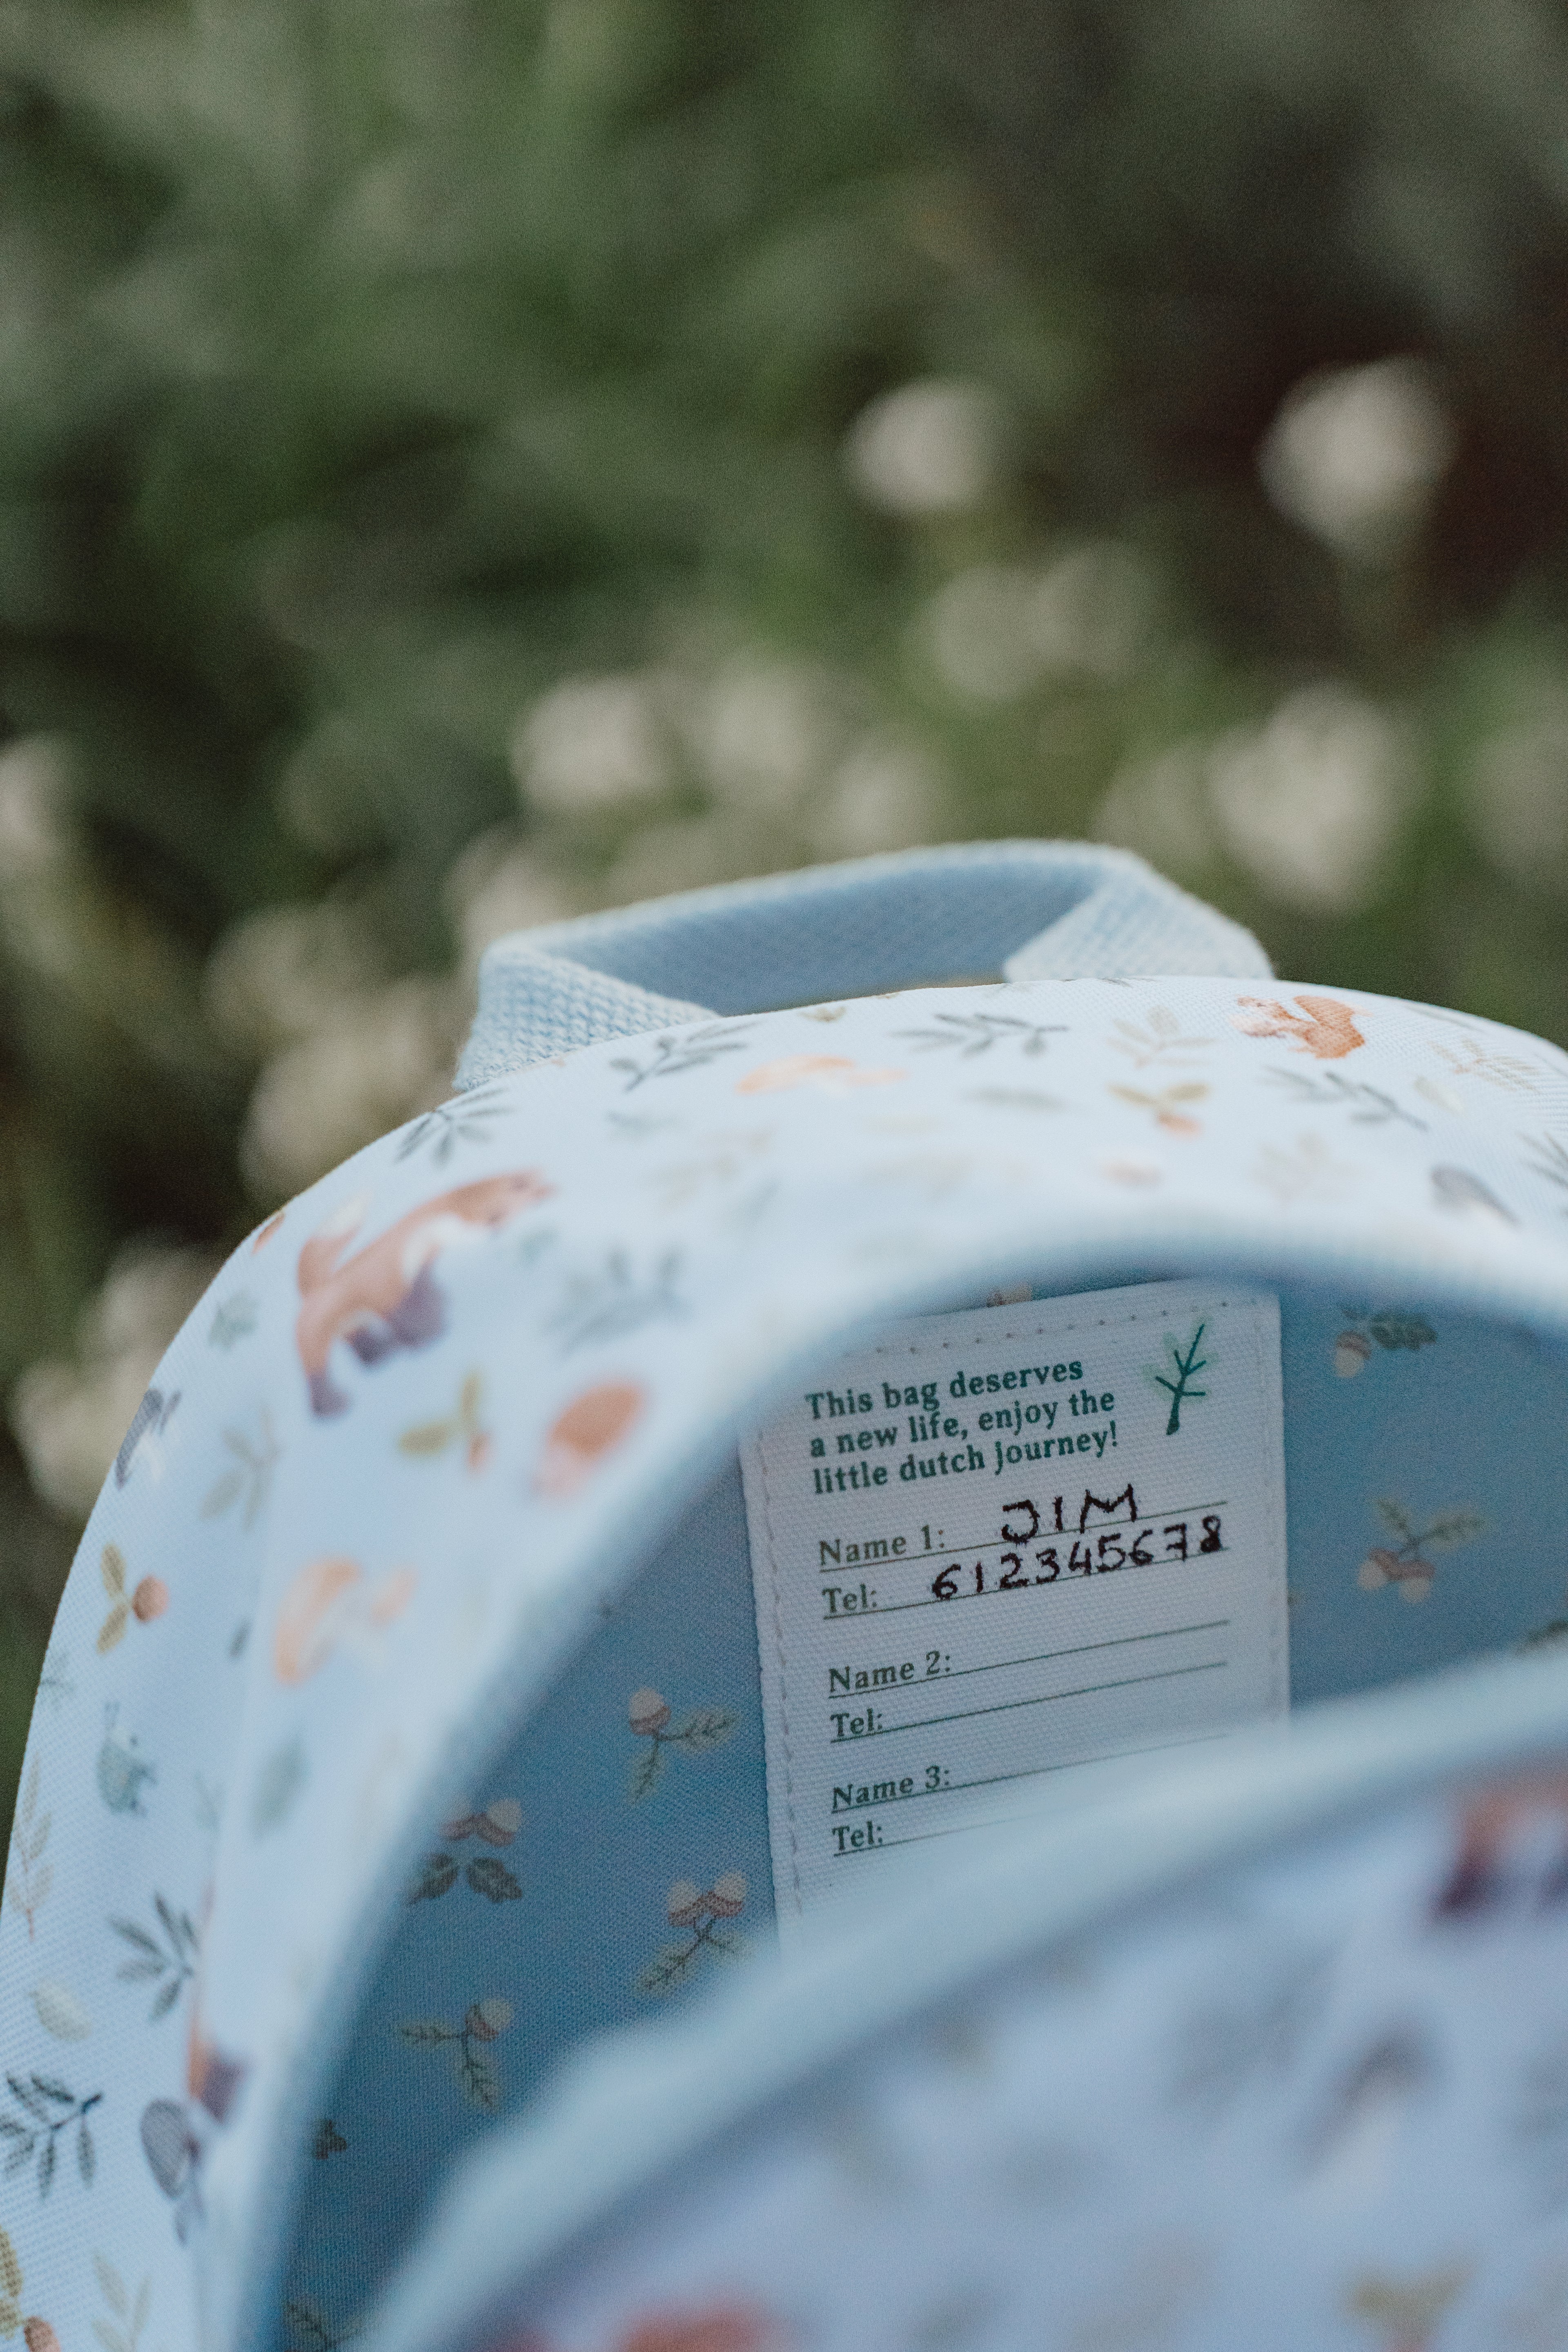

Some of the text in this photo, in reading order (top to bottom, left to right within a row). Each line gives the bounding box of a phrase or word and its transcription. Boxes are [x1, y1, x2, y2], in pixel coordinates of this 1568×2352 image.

[806, 1359, 1084, 1419] This bag deserves
[810, 1389, 1115, 1458] a new life, enjoy the
[813, 1421, 1118, 1494] little dutch journey!
[1001, 1483, 1138, 1545] JIM
[819, 1525, 945, 1566] Name 1:
[932, 1515, 1223, 1601] 612345678
[822, 1584, 878, 1614] Tel:
[829, 1650, 951, 1693] Name 2:
[830, 1708, 883, 1737] Tel:
[832, 1766, 951, 1809] Name 3:
[832, 1822, 883, 1851] Tel:
